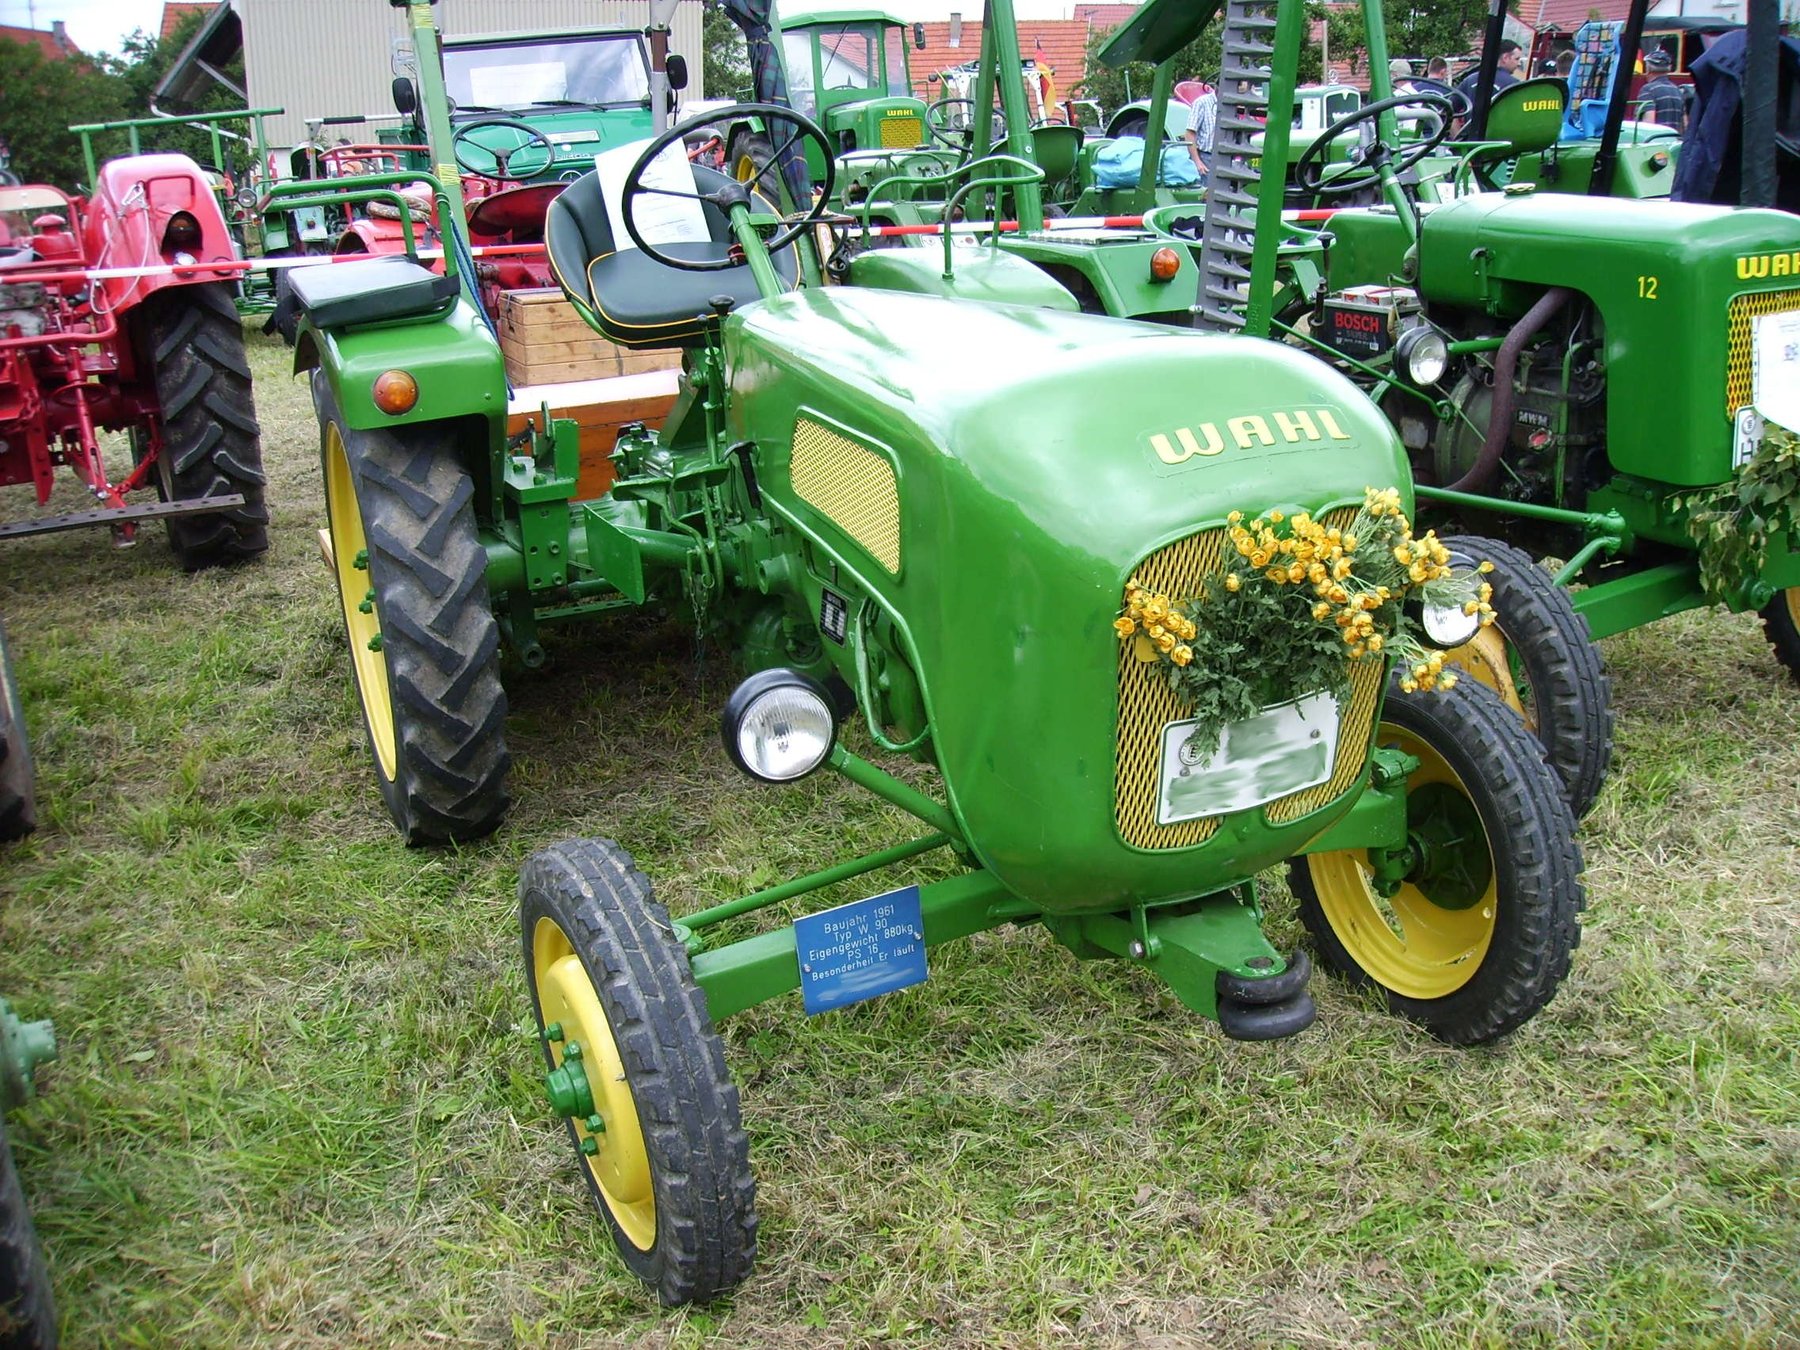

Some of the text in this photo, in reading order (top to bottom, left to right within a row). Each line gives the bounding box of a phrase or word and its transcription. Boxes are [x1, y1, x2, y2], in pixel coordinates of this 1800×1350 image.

[886, 109, 914, 117] WAHL
[1523, 100, 1560, 112] WAHL
[1637, 275, 1658, 300] 12
[1334, 312, 1379, 333] BOSCH
[1149, 409, 1352, 465] WAHL
[824, 904, 895, 934] Baujahr 1961
[834, 918, 888, 944] Typ W 90
[809, 924, 913, 961] Eigengewicht 880kg
[847, 943, 879, 961] PS 16
[812, 944, 915, 981] Besonderheit Er läuft
